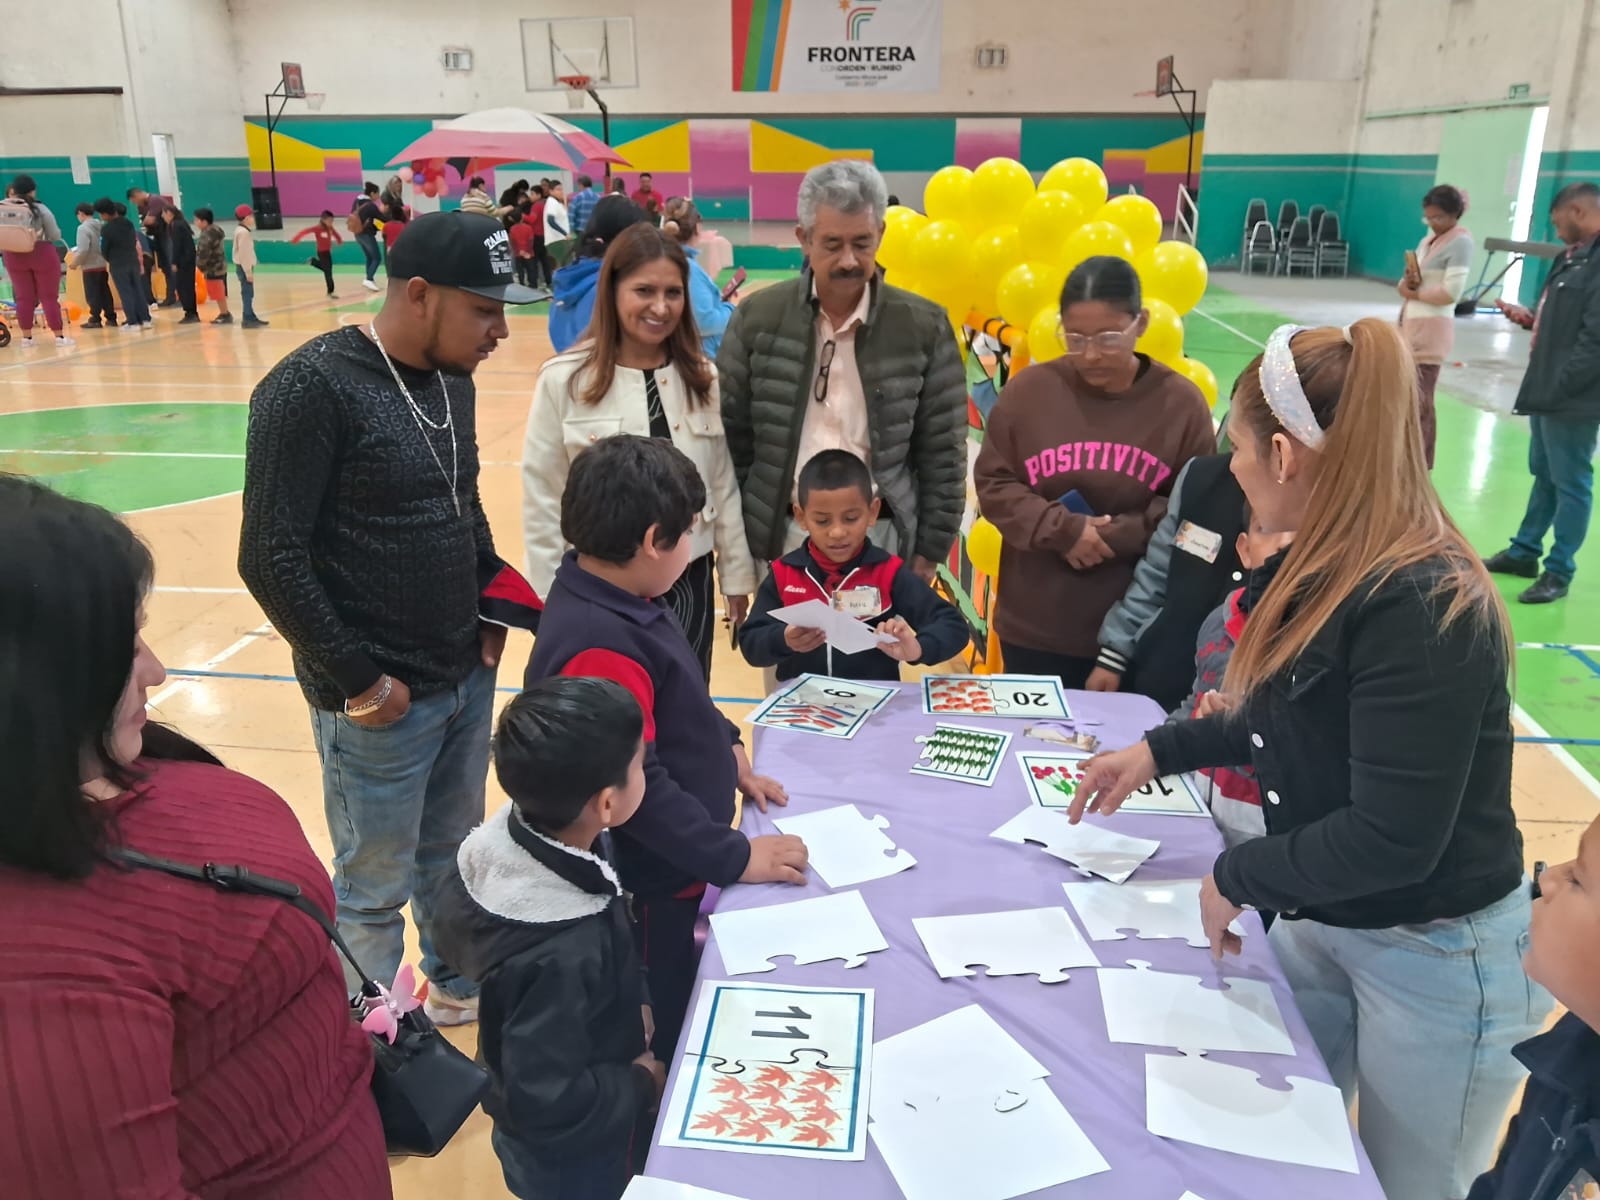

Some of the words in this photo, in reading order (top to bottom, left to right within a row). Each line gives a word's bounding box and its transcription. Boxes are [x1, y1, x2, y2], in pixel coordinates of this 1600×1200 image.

[808, 46, 916, 62] FRONTERA
[1024, 441, 1171, 492] POSITIVITY
[1012, 691, 1049, 707] 20
[751, 1005, 812, 1040] 11
